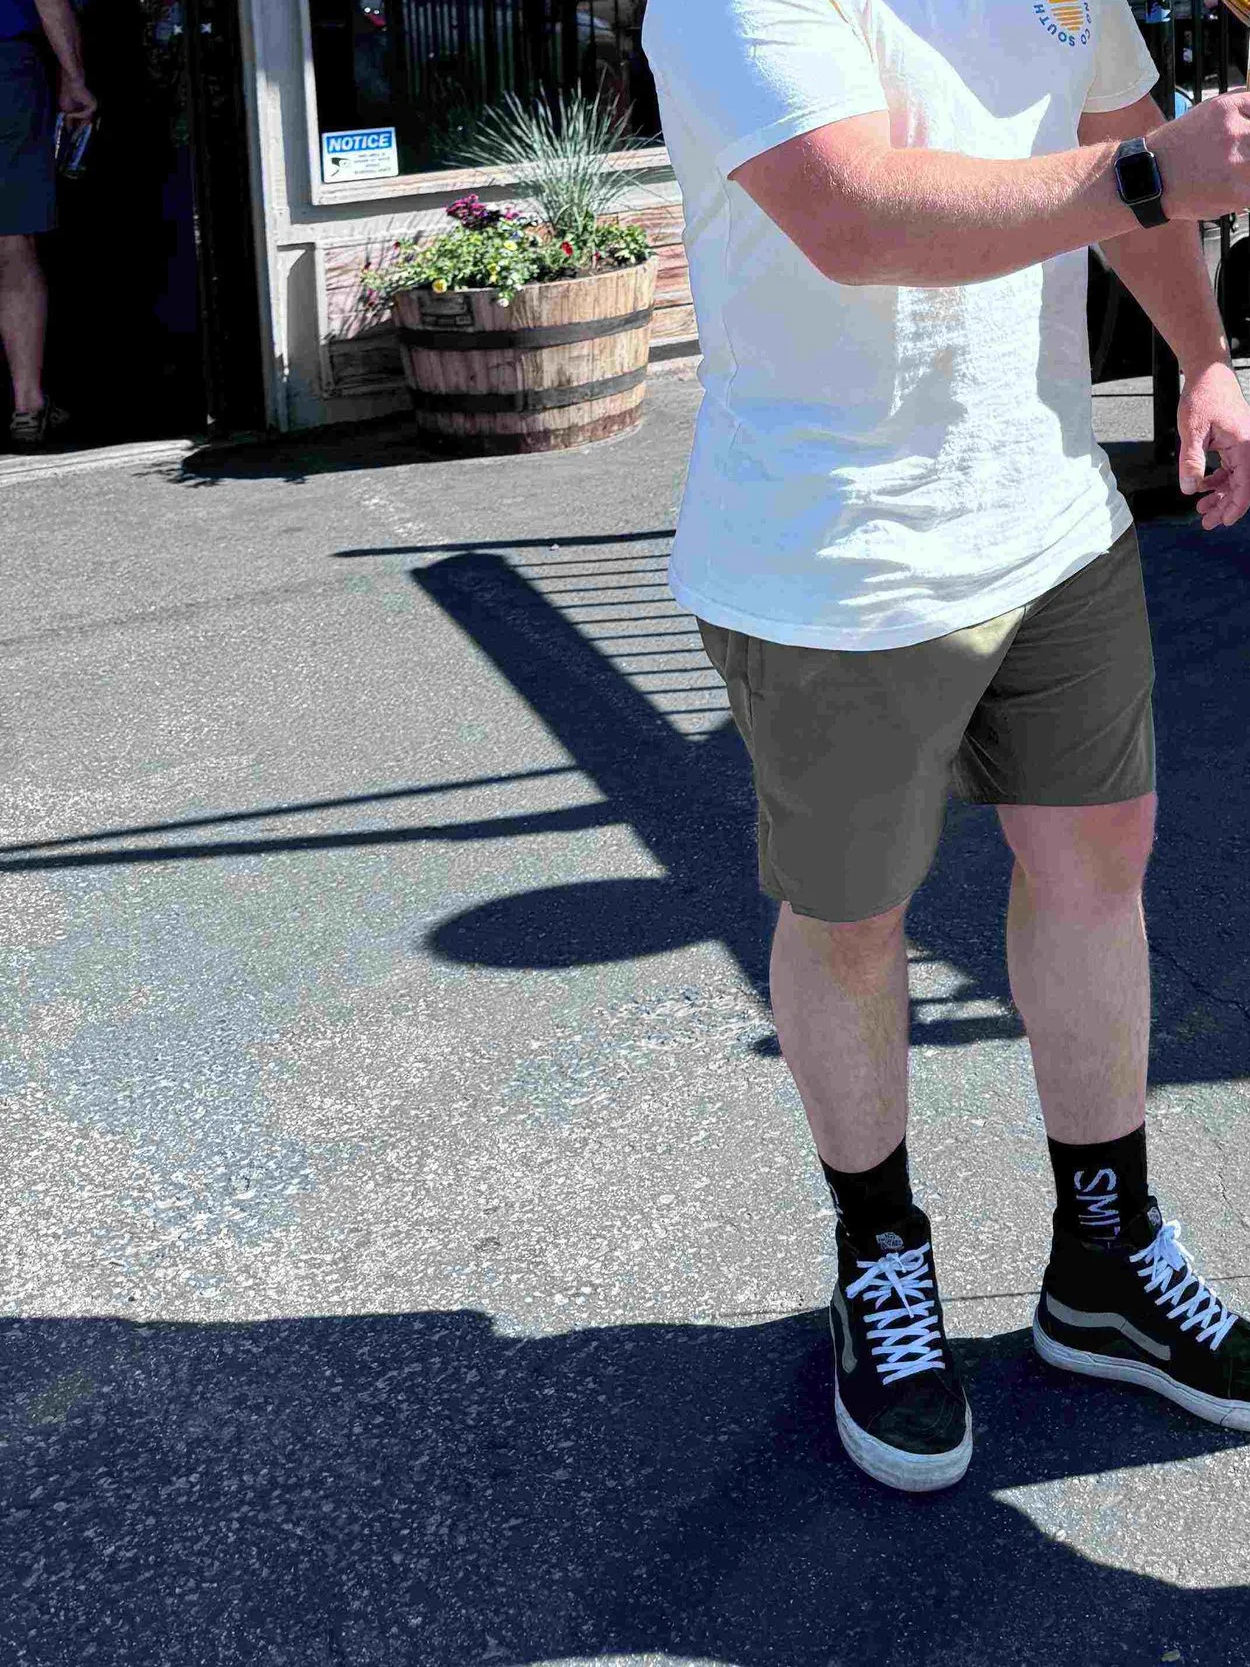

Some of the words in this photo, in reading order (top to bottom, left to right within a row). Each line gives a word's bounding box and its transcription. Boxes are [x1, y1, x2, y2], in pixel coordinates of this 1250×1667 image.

[1033, 3, 1076, 47] SOUTH
[1080, 28, 1091, 45] CO
[329, 134, 390, 151] NOTICE
